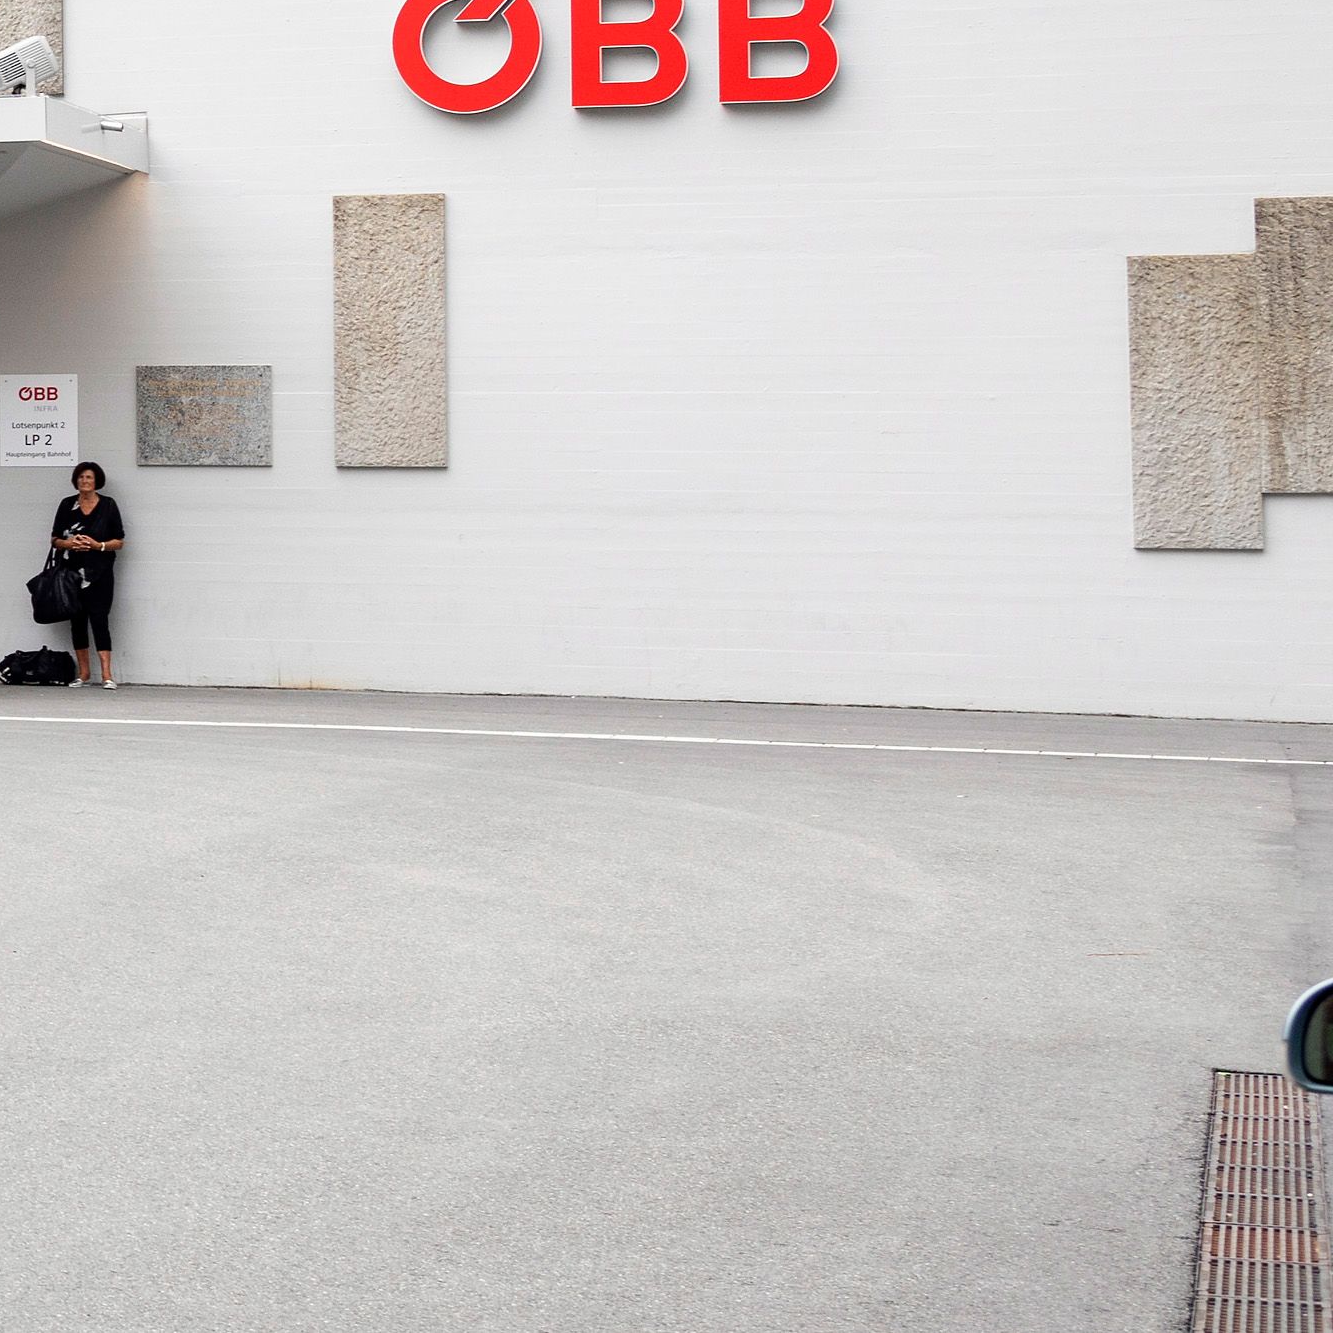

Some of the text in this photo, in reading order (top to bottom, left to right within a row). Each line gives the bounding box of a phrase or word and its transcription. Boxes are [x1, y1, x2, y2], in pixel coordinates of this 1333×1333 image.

[18, 387, 59, 401] ÖBB
[12, 421, 65, 430] Lotsenpunkt 2
[25, 434, 52, 446] LP 2
